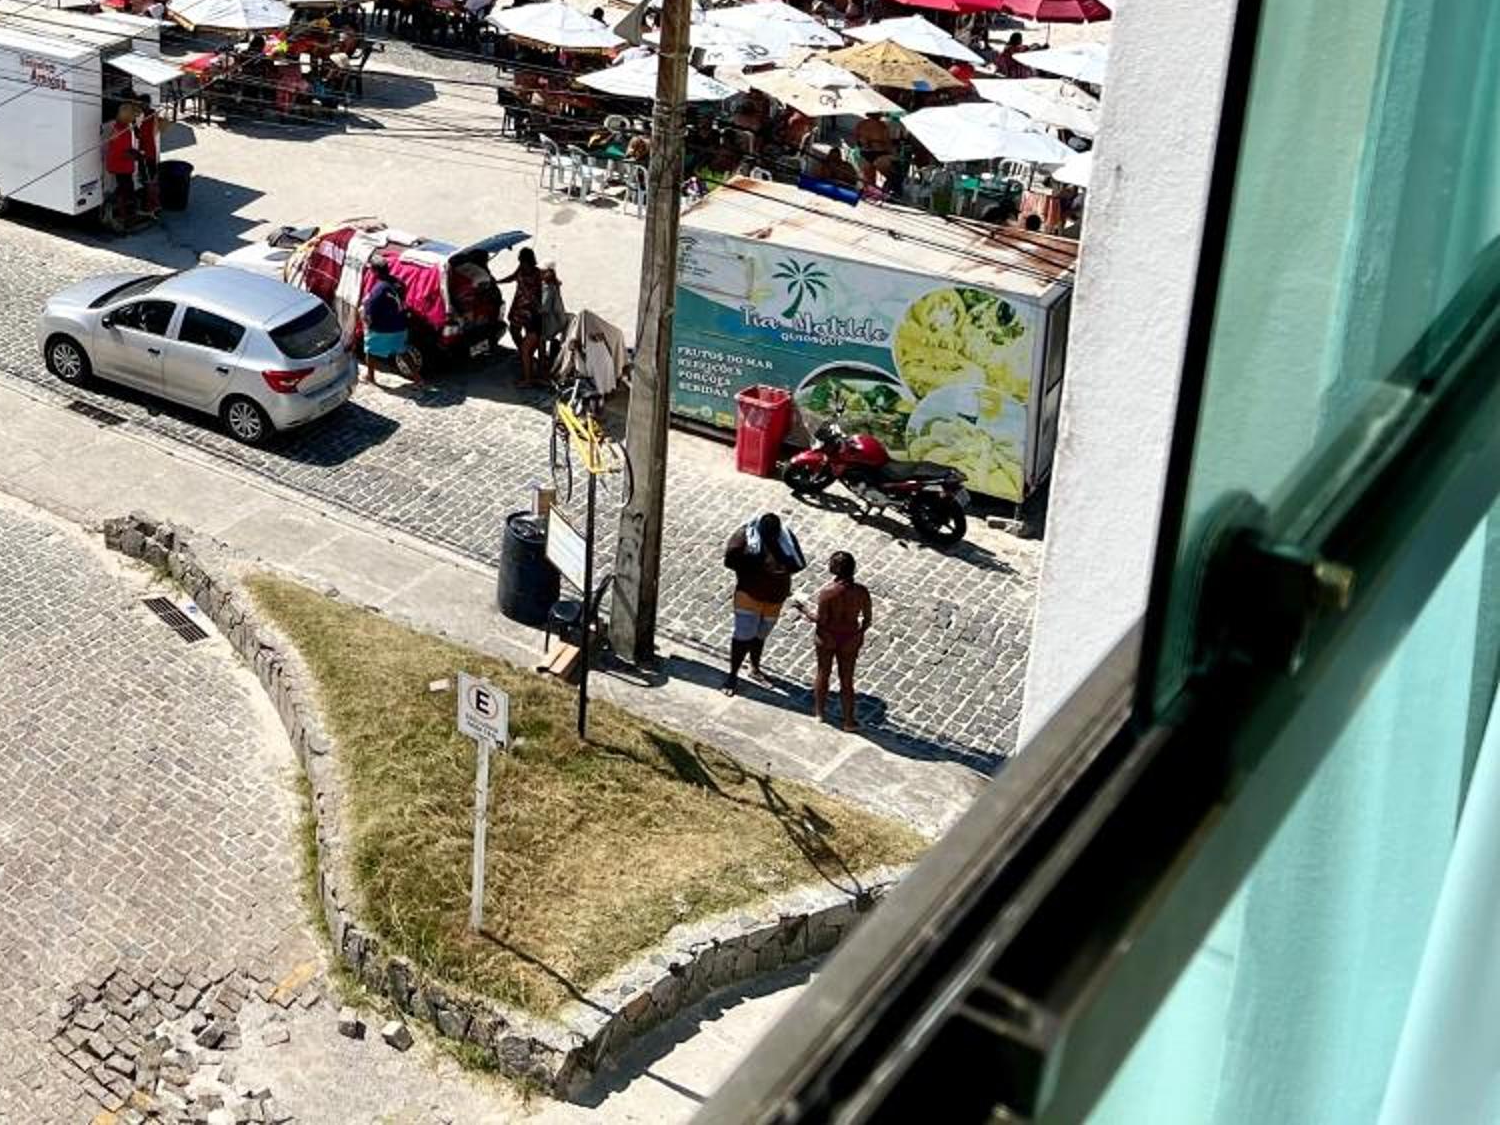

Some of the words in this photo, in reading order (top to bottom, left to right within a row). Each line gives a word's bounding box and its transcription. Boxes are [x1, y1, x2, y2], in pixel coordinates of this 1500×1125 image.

[740, 305, 779, 329] Tia
[677, 346, 724, 362] FRUTOS
[727, 354, 743, 364] DO
[746, 358, 773, 370] MAR
[678, 370, 731, 387] PORÇÕES
[678, 381, 729, 397] BEBIDAS
[476, 689, 489, 714] E
